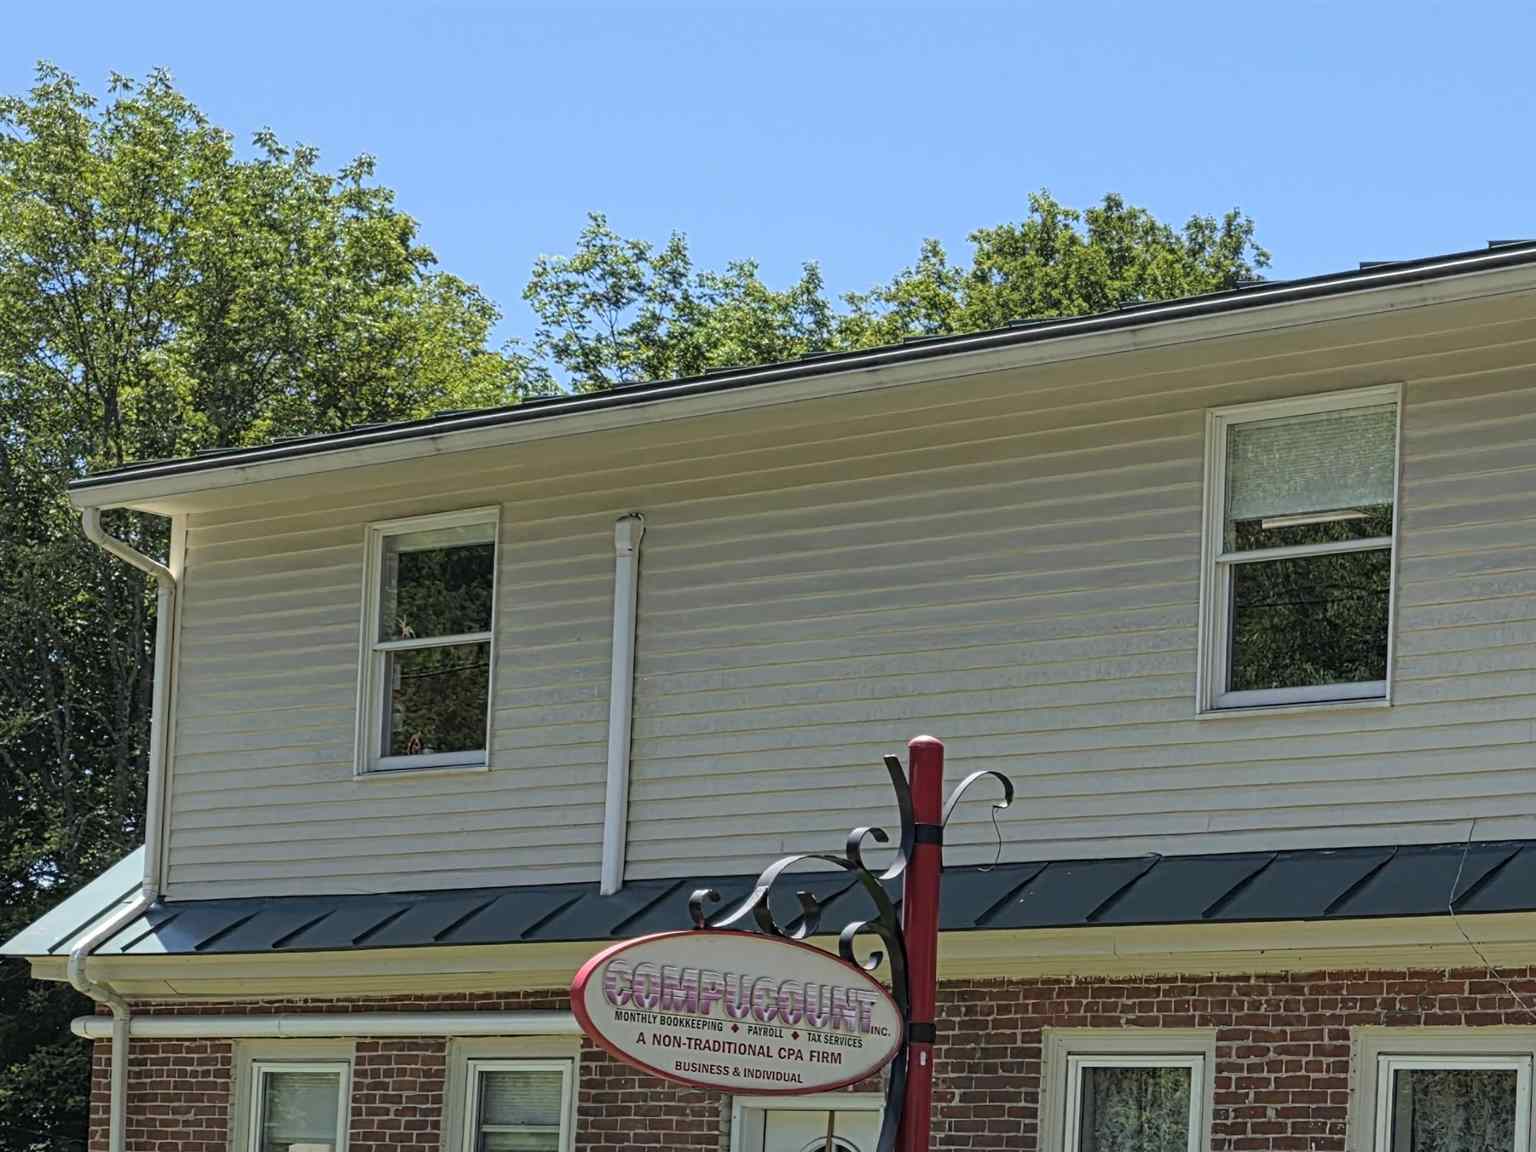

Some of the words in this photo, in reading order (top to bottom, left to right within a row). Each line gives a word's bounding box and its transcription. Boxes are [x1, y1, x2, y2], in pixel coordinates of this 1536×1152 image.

[603, 959, 879, 1034] COMPUCOUNT
[871, 1025, 891, 1037] INC.
[615, 1010, 657, 1024] MONTHLY
[660, 1015, 723, 1031] BOOKKEEPING
[748, 1025, 784, 1039] PAYROLL
[807, 1033, 821, 1043] TAX
[824, 1035, 863, 1048] SERVICES
[636, 1032, 646, 1044] A
[652, 1033, 773, 1058] NON-TRADITIONAL
[778, 1047, 804, 1061] CPA
[809, 1050, 842, 1064] FIRM
[675, 1061, 729, 1076] BUSINESS
[732, 1067, 741, 1077] &
[743, 1067, 803, 1084] INDIVIDUAL
